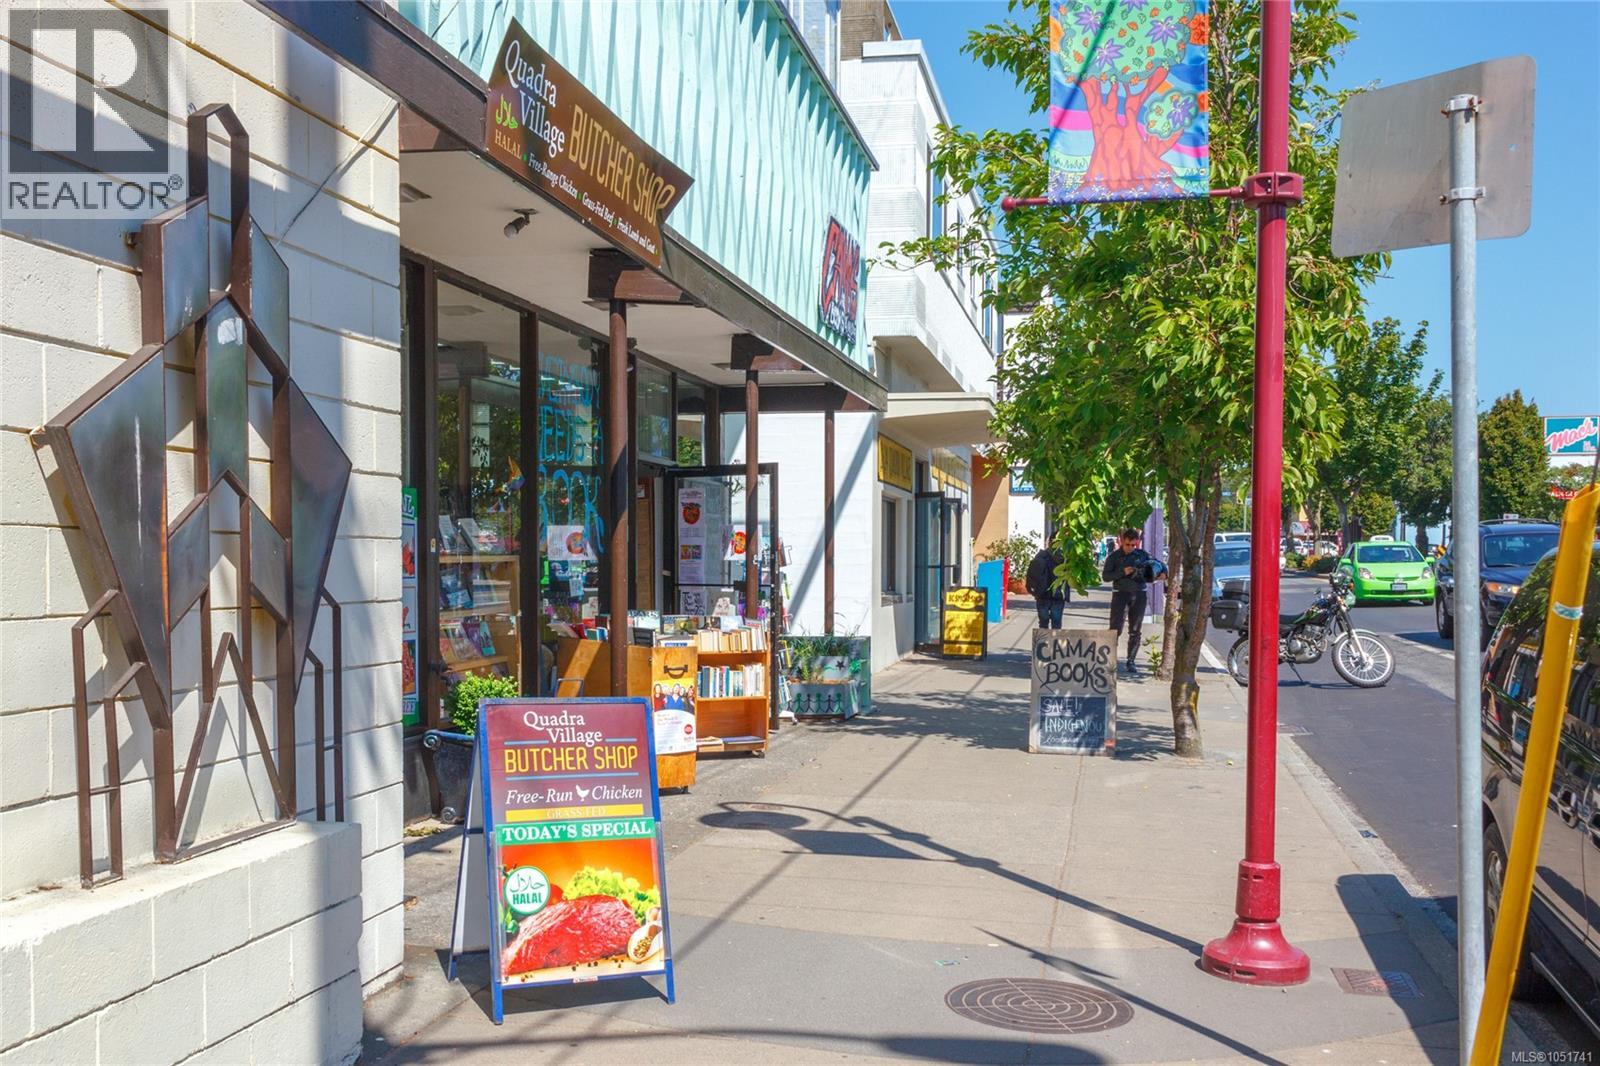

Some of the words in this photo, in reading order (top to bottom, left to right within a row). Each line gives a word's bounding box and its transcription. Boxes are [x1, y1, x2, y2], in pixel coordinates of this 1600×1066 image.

[504, 39, 557, 107] Quadra
[519, 90, 566, 158] Village
[495, 129, 522, 160] HALAL
[568, 104, 634, 206] BUTCHER
[633, 162, 676, 227] SHOP
[529, 153, 559, 187] Free-Range
[559, 174, 579, 200] Chicken
[582, 192, 605, 217] Grass-Fed
[604, 207, 615, 228] Beef
[628, 225, 640, 242] Lamb
[1036, 638, 1111, 665] CAMAS
[1040, 661, 1111, 693] BOOKS
[523, 710, 586, 730] Quadra
[546, 727, 603, 748] Village
[504, 746, 589, 773] BUTCHER
[593, 745, 639, 770] SHOP
[591, 785, 643, 800] Chicken
[502, 823, 578, 842] TODAY'S
[581, 820, 651, 838] SPECIAL
[512, 892, 543, 905] HALAL
